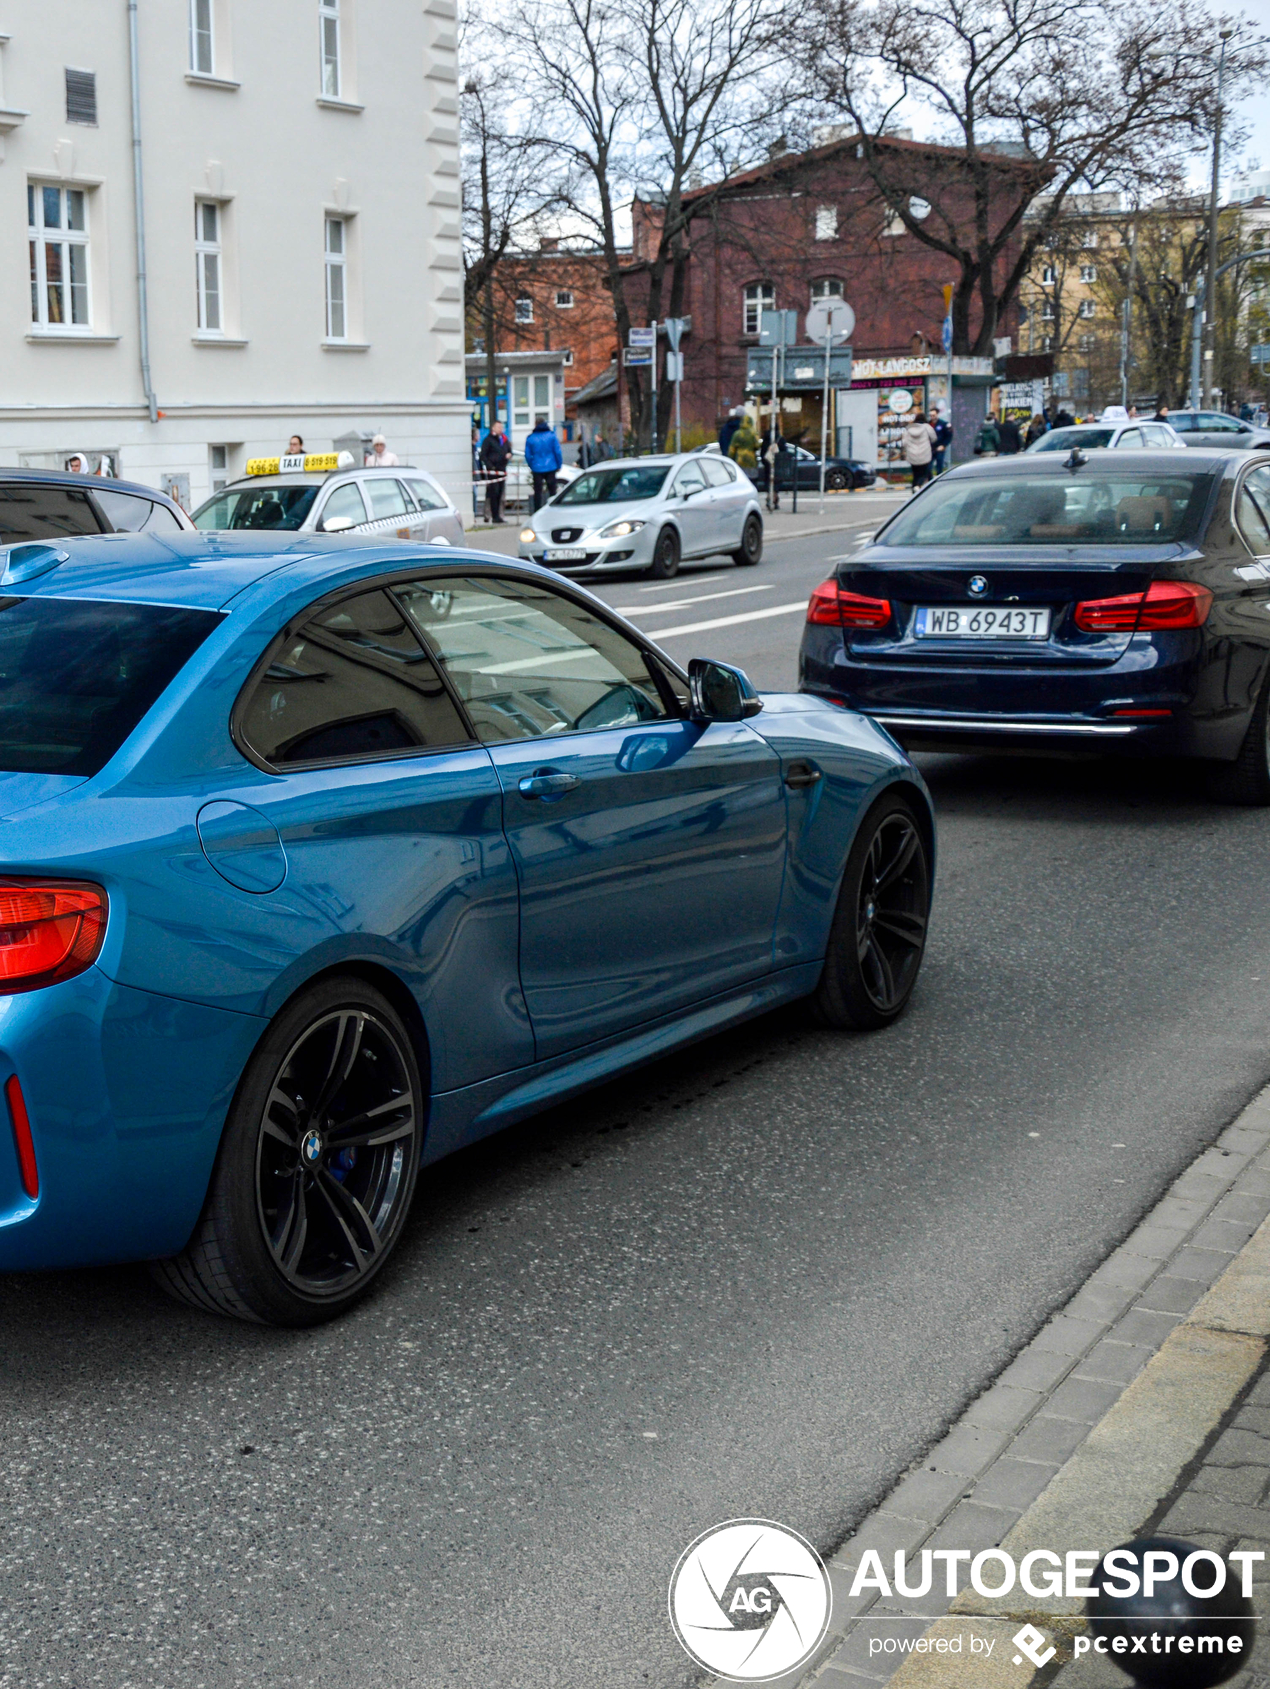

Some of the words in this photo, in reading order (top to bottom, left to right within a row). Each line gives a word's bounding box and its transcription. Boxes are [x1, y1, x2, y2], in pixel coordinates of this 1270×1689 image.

[283, 457, 302, 469] TAXI
[932, 611, 959, 633] WB
[969, 611, 1043, 633] 6943T
